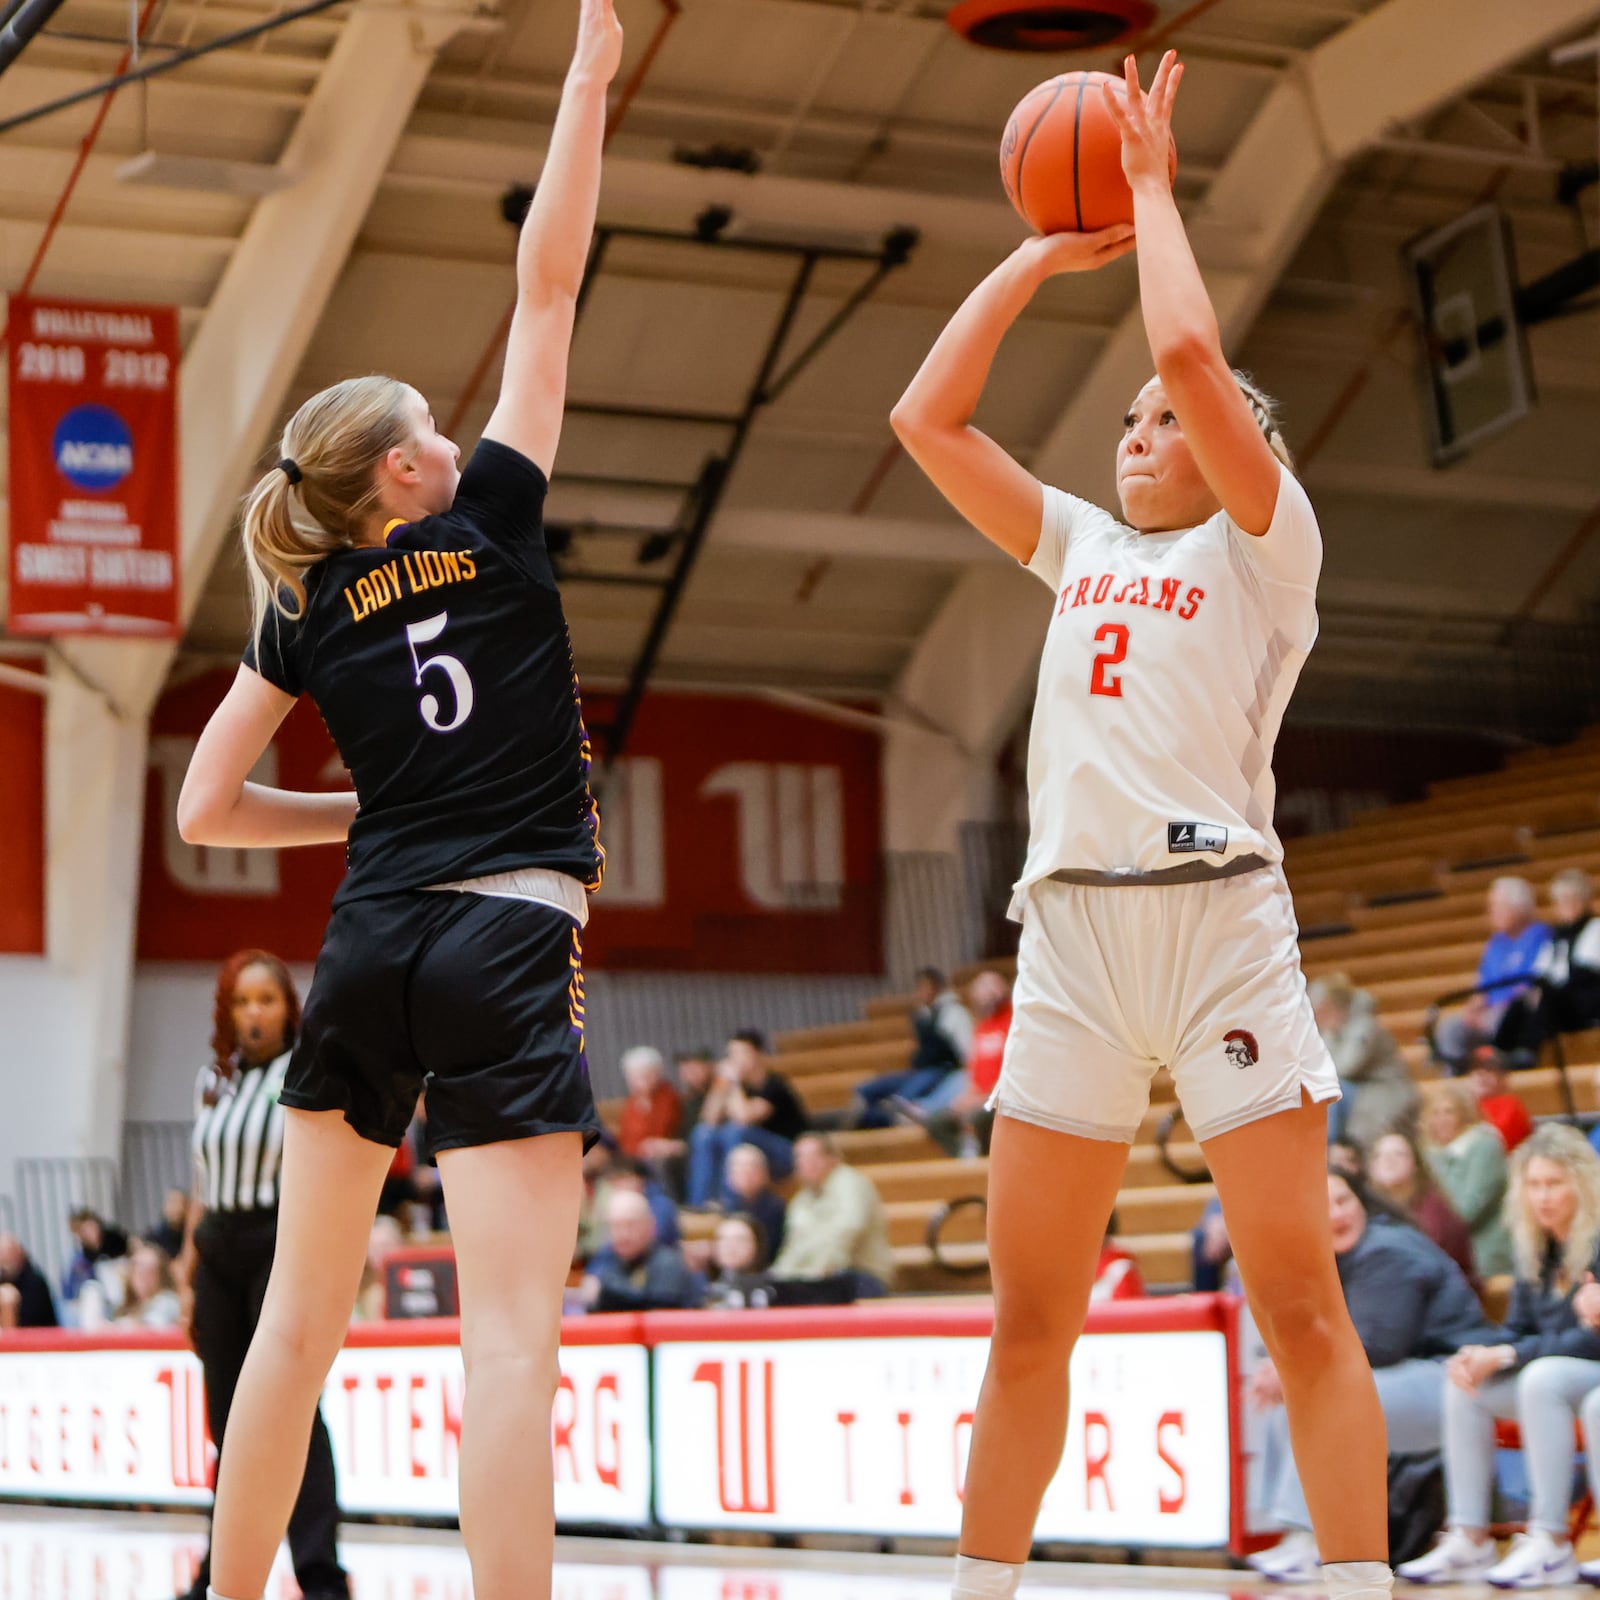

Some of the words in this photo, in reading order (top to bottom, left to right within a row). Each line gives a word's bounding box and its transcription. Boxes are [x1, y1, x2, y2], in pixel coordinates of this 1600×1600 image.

[33, 307, 154, 345] VOLLEYBALL
[59, 440, 133, 474] NCAA
[344, 560, 403, 623] LADY
[403, 549, 478, 594] LIONS
[1057, 573, 1206, 621] TROJANS
[405, 610, 475, 733] 5
[1089, 622, 1131, 699] 2
[1205, 838, 1216, 848] M
